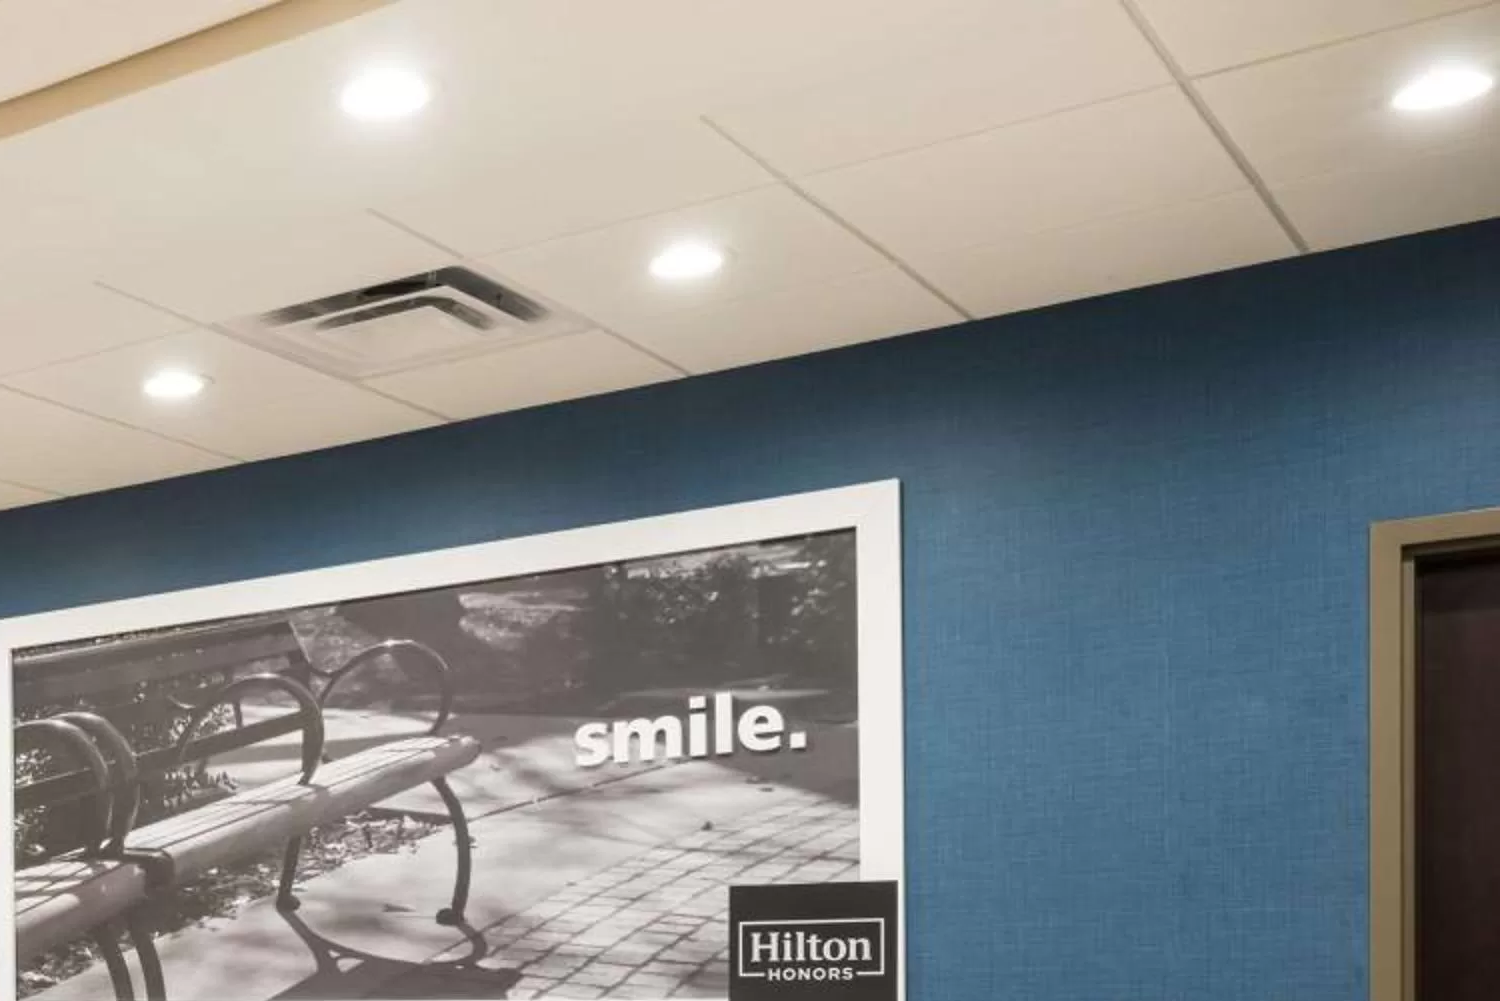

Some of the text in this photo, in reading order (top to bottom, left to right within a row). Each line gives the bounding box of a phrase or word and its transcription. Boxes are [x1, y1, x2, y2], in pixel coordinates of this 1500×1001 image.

[575, 691, 807, 766] smile.
[750, 931, 873, 963] Hilton
[767, 967, 854, 981] HONORS
